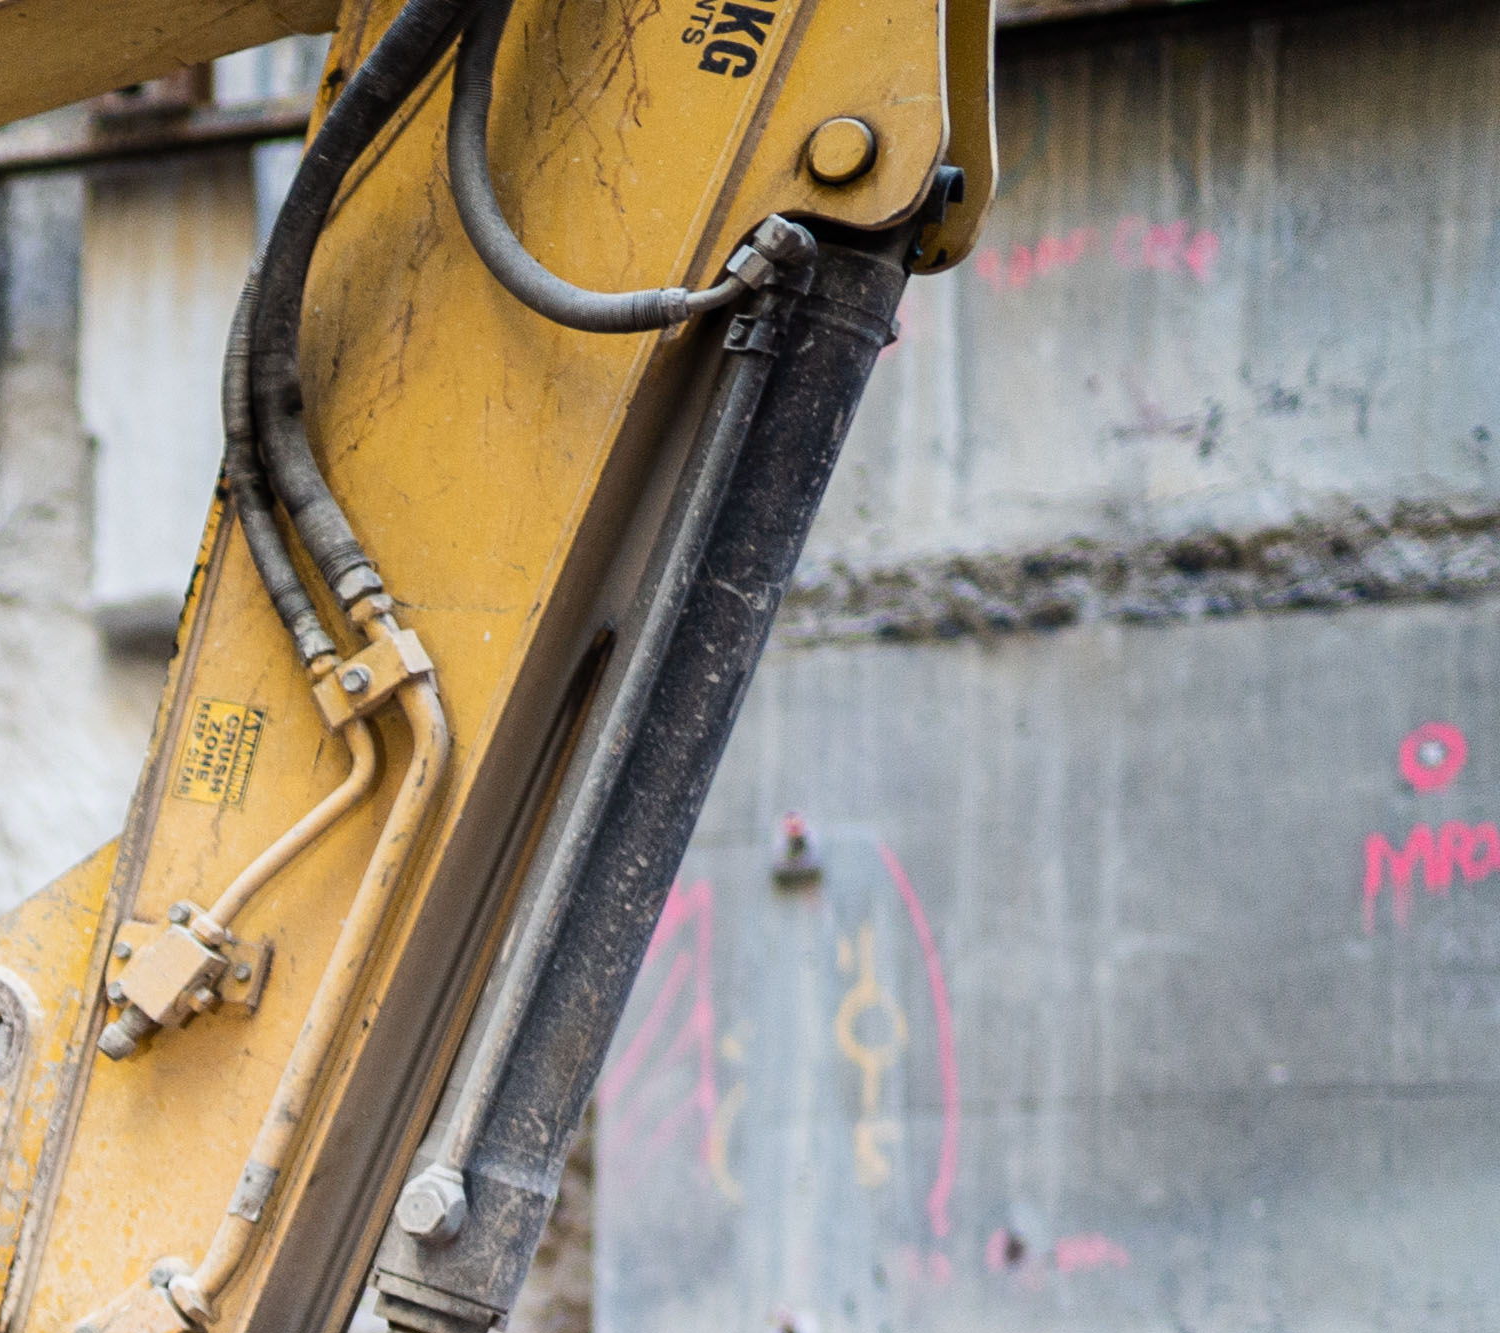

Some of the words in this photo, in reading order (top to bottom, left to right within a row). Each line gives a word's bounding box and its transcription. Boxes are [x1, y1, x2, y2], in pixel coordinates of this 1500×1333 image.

[698, 0, 776, 79] KG
[196, 721, 221, 781] ZONE
[211, 715, 240, 793] CRUSH
